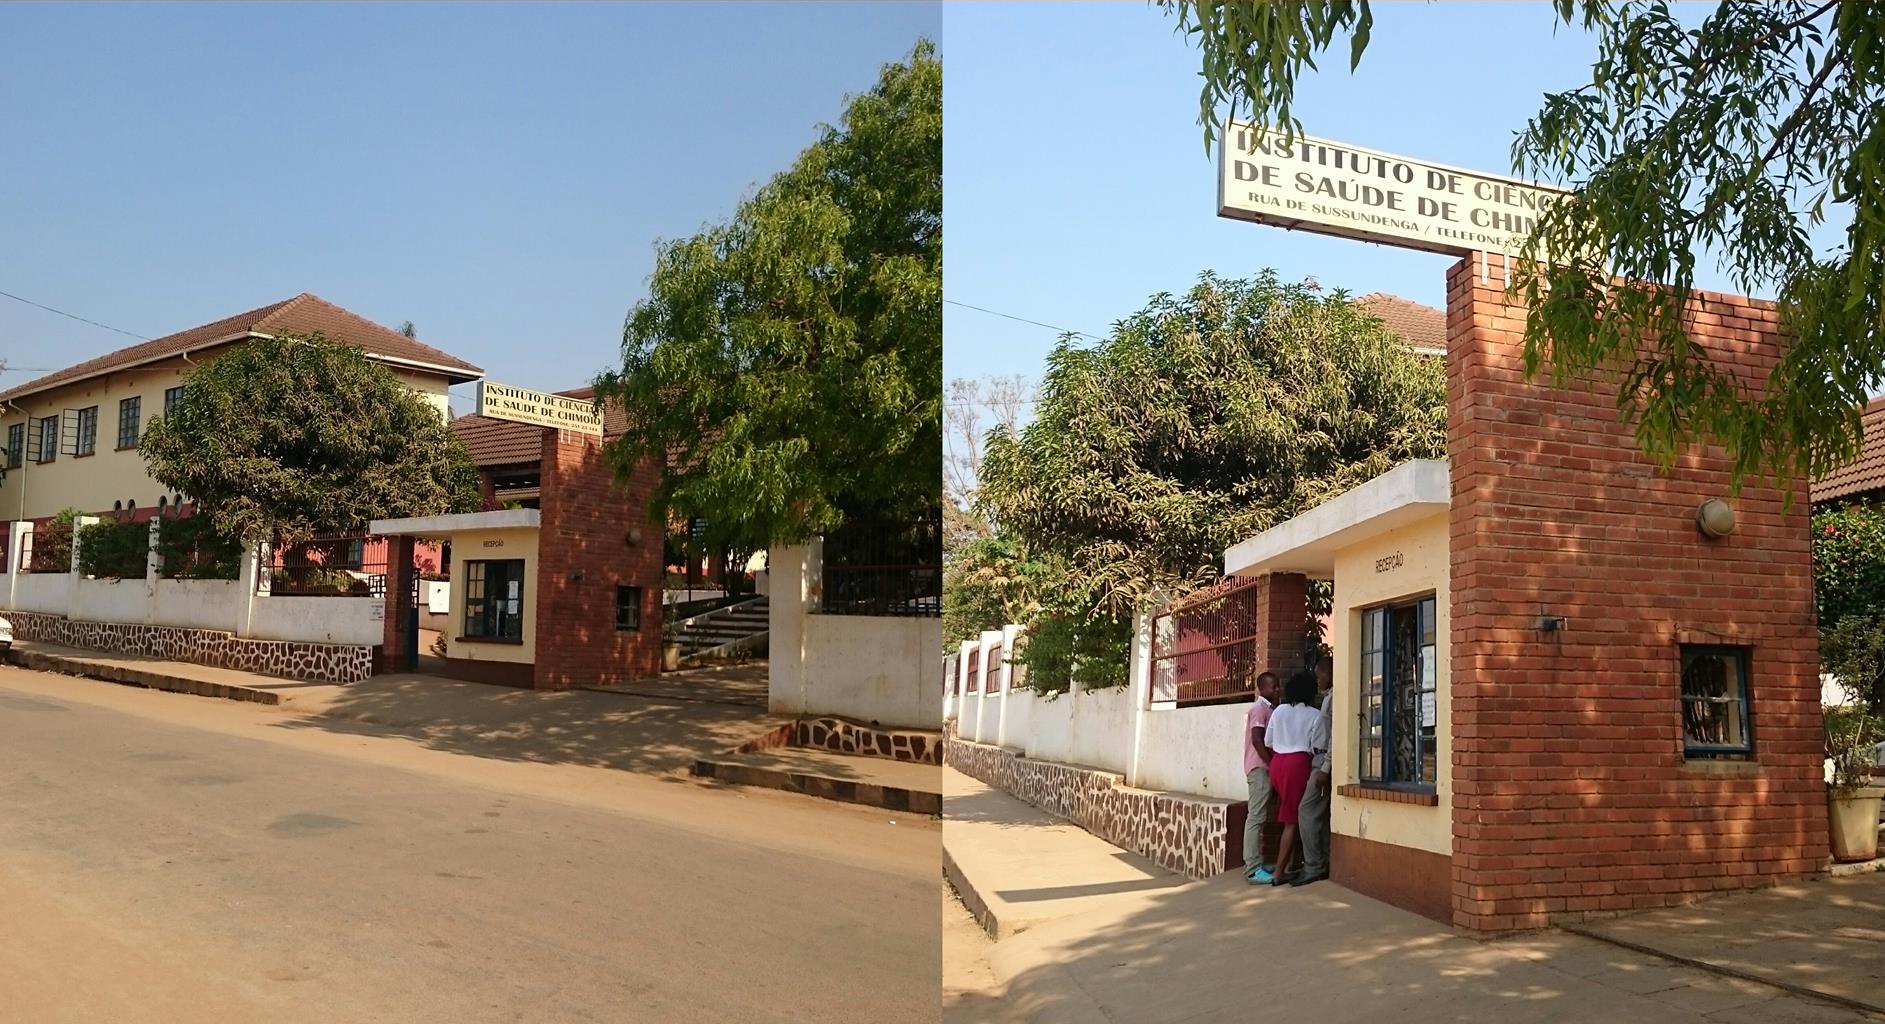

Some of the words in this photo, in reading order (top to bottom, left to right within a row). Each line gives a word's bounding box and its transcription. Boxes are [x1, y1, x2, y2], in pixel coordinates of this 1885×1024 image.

[1236, 129, 1414, 184] INSTITUTO
[1427, 170, 1464, 195] DE
[1233, 159, 1282, 188] DE
[1294, 171, 1407, 212] SAÚDE
[1418, 197, 1459, 223] DE
[1248, 191, 1281, 207] RUA
[1286, 199, 1307, 212] DE
[1311, 204, 1420, 233] SUSSUNDENGA
[485, 396, 500, 407] DE
[541, 408, 554, 418] DE
[557, 410, 601, 426] CHIMOIO
[486, 384, 541, 403] INSTITUTO
[544, 396, 557, 406] DE
[1375, 550, 1404, 573] RECEPÇÃO
